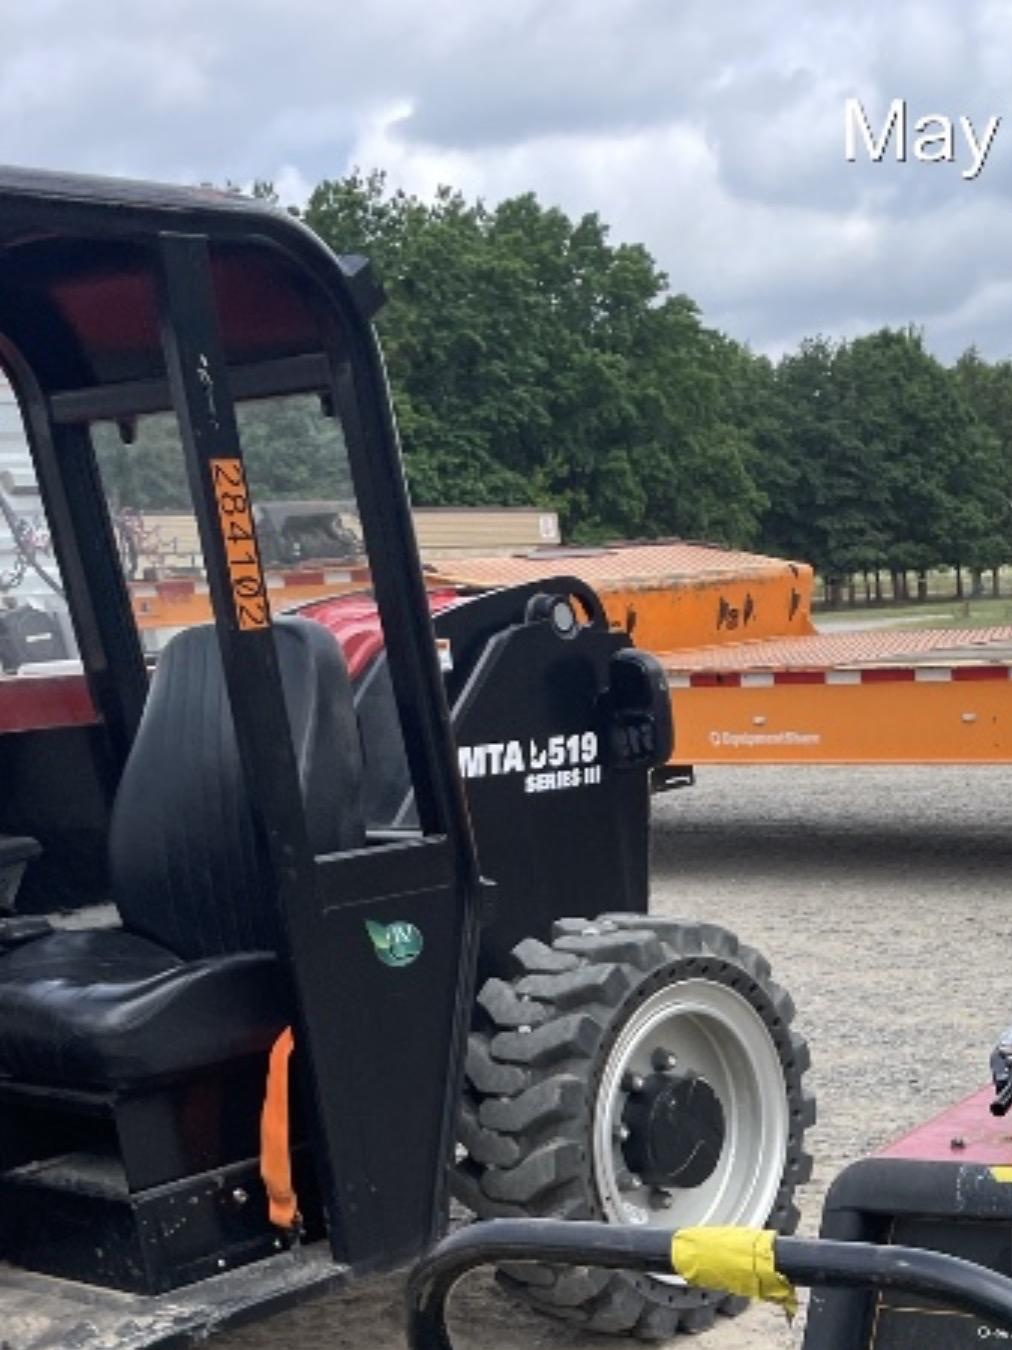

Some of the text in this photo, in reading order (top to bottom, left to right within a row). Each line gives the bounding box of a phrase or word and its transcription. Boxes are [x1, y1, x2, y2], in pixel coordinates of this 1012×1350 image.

[215, 463, 265, 627] 284102
[458, 740, 525, 778] MTA
[525, 765, 601, 793] SERIES III
